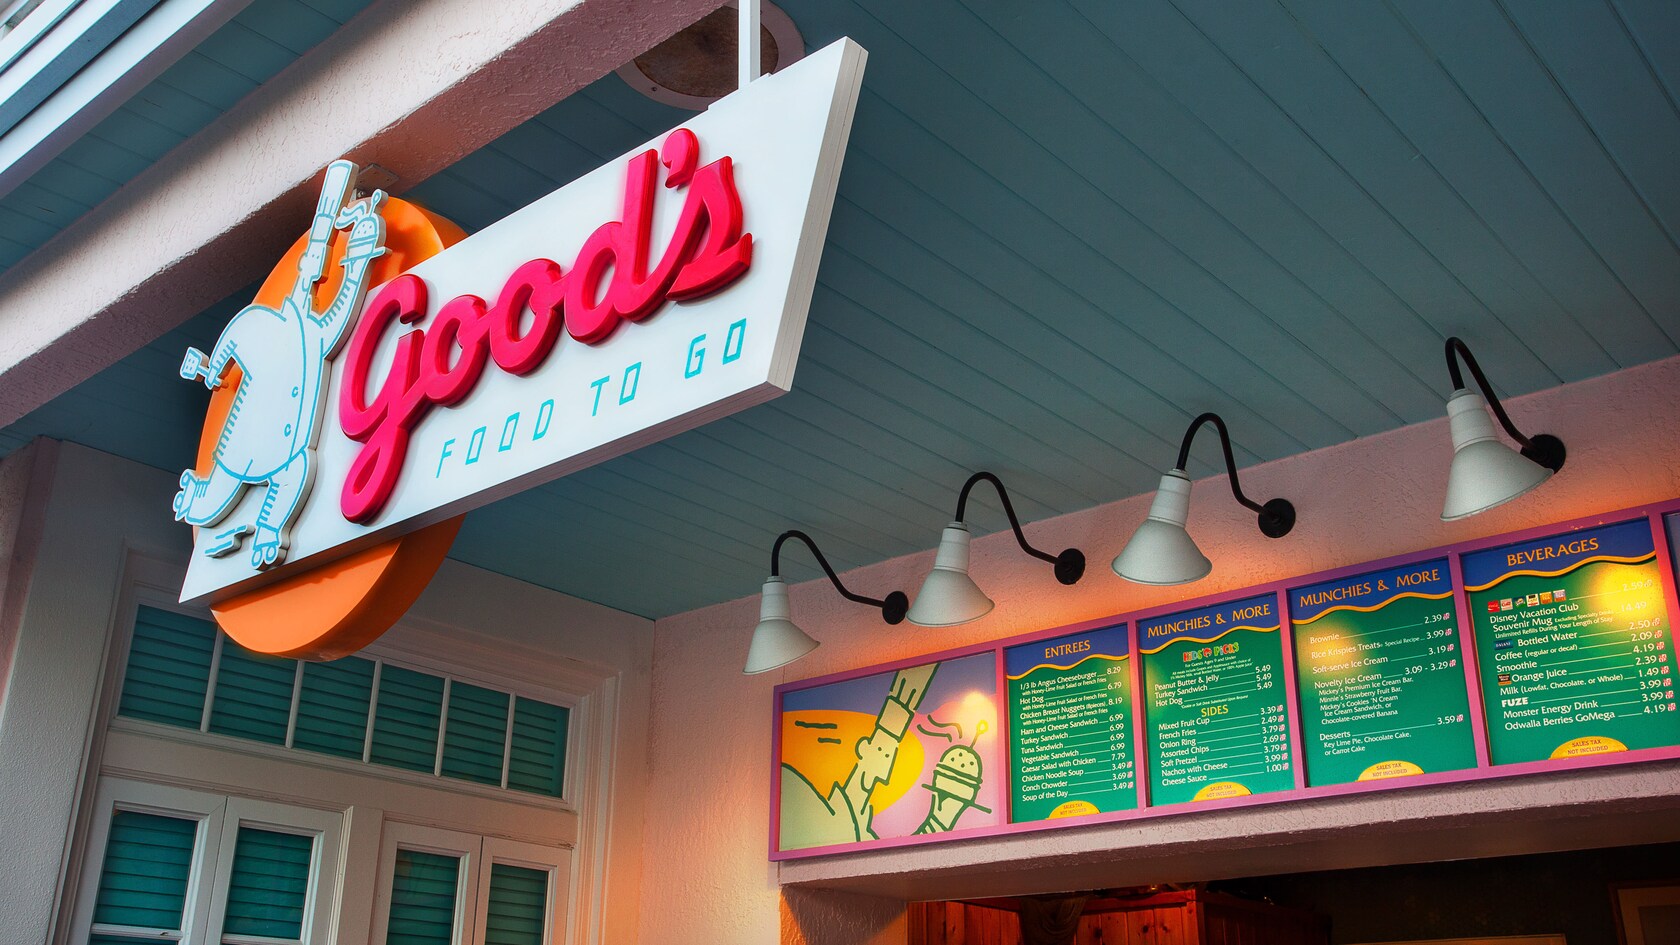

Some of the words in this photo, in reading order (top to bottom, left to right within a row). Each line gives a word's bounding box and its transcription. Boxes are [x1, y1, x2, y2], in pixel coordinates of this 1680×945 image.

[339, 128, 752, 524] Good's
[436, 398, 554, 478] FOOD
[591, 362, 642, 417] TO
[685, 317, 747, 379] GO
[1507, 538, 1599, 566] BEVERAGES
[1300, 582, 1371, 607] MUNCHIES
[1377, 580, 1389, 591] &
[1396, 569, 1440, 588] MORE
[1148, 616, 1210, 638] MUNCHIES
[1216, 614, 1226, 624] &
[1232, 604, 1270, 621] MORE
[1490, 613, 1517, 624] Disney
[1520, 609, 1556, 620] Vacation
[1558, 603, 1579, 613] Club
[1310, 633, 1339, 643] Brownie
[1424, 614, 1442, 624] 2.39
[1493, 621, 1529, 633] Souvenir
[1532, 618, 1552, 626] Mug
[1518, 635, 1549, 646] Bottled
[1551, 631, 1577, 641] Water
[1629, 620, 1650, 631] 2.50
[1539, 625, 1557, 633] During
[1045, 640, 1091, 658] ENTREES
[1311, 651, 1326, 659] Rice
[1328, 645, 1356, 657] Krispies
[1426, 630, 1444, 640] 3.99
[1495, 651, 1522, 661] Coffee
[1631, 631, 1652, 642] 2.09
[1313, 662, 1349, 674] Soft-serve
[1351, 660, 1362, 668] Ice
[1364, 656, 1388, 665] Cream
[1429, 646, 1446, 655] 3.19
[1497, 661, 1537, 673] Smoothie
[1633, 643, 1654, 653] 4.19
[1512, 671, 1544, 682] Orange
[1546, 668, 1567, 678] Juice
[1636, 655, 1656, 666] 2.39
[1021, 681, 1029, 690] 1/3
[1038, 679, 1056, 687] Angus
[1057, 671, 1097, 683] Cheeseburger
[1107, 666, 1121, 674] 8.29
[1108, 682, 1121, 690] 6.79
[1155, 682, 1176, 691] Peanut
[1178, 678, 1196, 686] Butter
[1255, 665, 1270, 673] 5.49
[1257, 682, 1272, 690] 5.49
[1315, 678, 1342, 689] Novelty
[1345, 674, 1356, 683] Ice
[1357, 673, 1381, 682] Cream
[1404, 665, 1422, 675] 3.09
[1430, 661, 1448, 671] 3.29
[1345, 683, 1370, 692] Premium
[1382, 679, 1401, 687] Cream
[1500, 687, 1518, 695] Milk
[1638, 667, 1659, 678] 1.49
[1155, 689, 1178, 698] Turkey
[1177, 685, 1208, 695] Sandwich
[1344, 690, 1376, 700] Strawberry
[1502, 698, 1528, 707] FUZE
[1640, 680, 1661, 690] 3.99
[1020, 711, 1041, 719] Chicken
[1061, 705, 1085, 713] Nuggets
[1108, 697, 1122, 705] 8.19
[1201, 705, 1228, 717] SIDES
[1503, 708, 1539, 719] Monster
[1541, 703, 1573, 714] Energy
[1574, 700, 1598, 710] Drink
[1642, 692, 1663, 702] 3.99
[1047, 723, 1068, 731] Cheese
[1070, 718, 1098, 728] Sandwich
[1109, 714, 1123, 722] 6.99
[1159, 722, 1179, 731] Mixed
[1196, 718, 1210, 726] Cup
[1260, 706, 1276, 715] 3.39
[1160, 730, 1180, 739] French
[1261, 716, 1276, 724] 2.49
[1320, 732, 1350, 741] Desserts
[1437, 716, 1455, 726] 3.59
[1321, 714, 1375, 725] Chocolate-covered
[1377, 710, 1398, 718] Banana
[1505, 720, 1540, 731] Odwalla
[1543, 716, 1573, 726] Berries
[1576, 711, 1615, 722] GoMega
[1644, 704, 1665, 714] 4.19
[1021, 737, 1040, 745] Turkey
[1040, 732, 1068, 742] Sandwich
[1110, 723, 1124, 731] 6.99
[1262, 725, 1278, 734] 3.79
[1036, 743, 1063, 752] Sandwich
[1110, 733, 1124, 741] 6.99
[1161, 748, 1189, 758] Assorted
[1191, 746, 1209, 754] Chips
[1263, 735, 1278, 744] 2.69
[1324, 741, 1335, 749] Key
[1364, 733, 1393, 743] Chocolate
[1022, 754, 1049, 764] Vegetable
[1051, 750, 1079, 760] Sandwich
[1111, 743, 1125, 751] 6.99
[1176, 757, 1197, 765] Pretzel
[1264, 744, 1280, 753] 3.79
[1203, 763, 1228, 771] Cheese
[1265, 754, 1280, 763] 3.99
[1022, 765, 1040, 773] Caesar
[1041, 762, 1057, 770] Salad
[1046, 770, 1067, 779] Noodle
[1068, 769, 1083, 777] Soup
[1112, 762, 1126, 770] 3.49
[1162, 778, 1186, 786] Cheese
[1188, 775, 1207, 783] Sauce
[1266, 764, 1281, 772] 1.00
